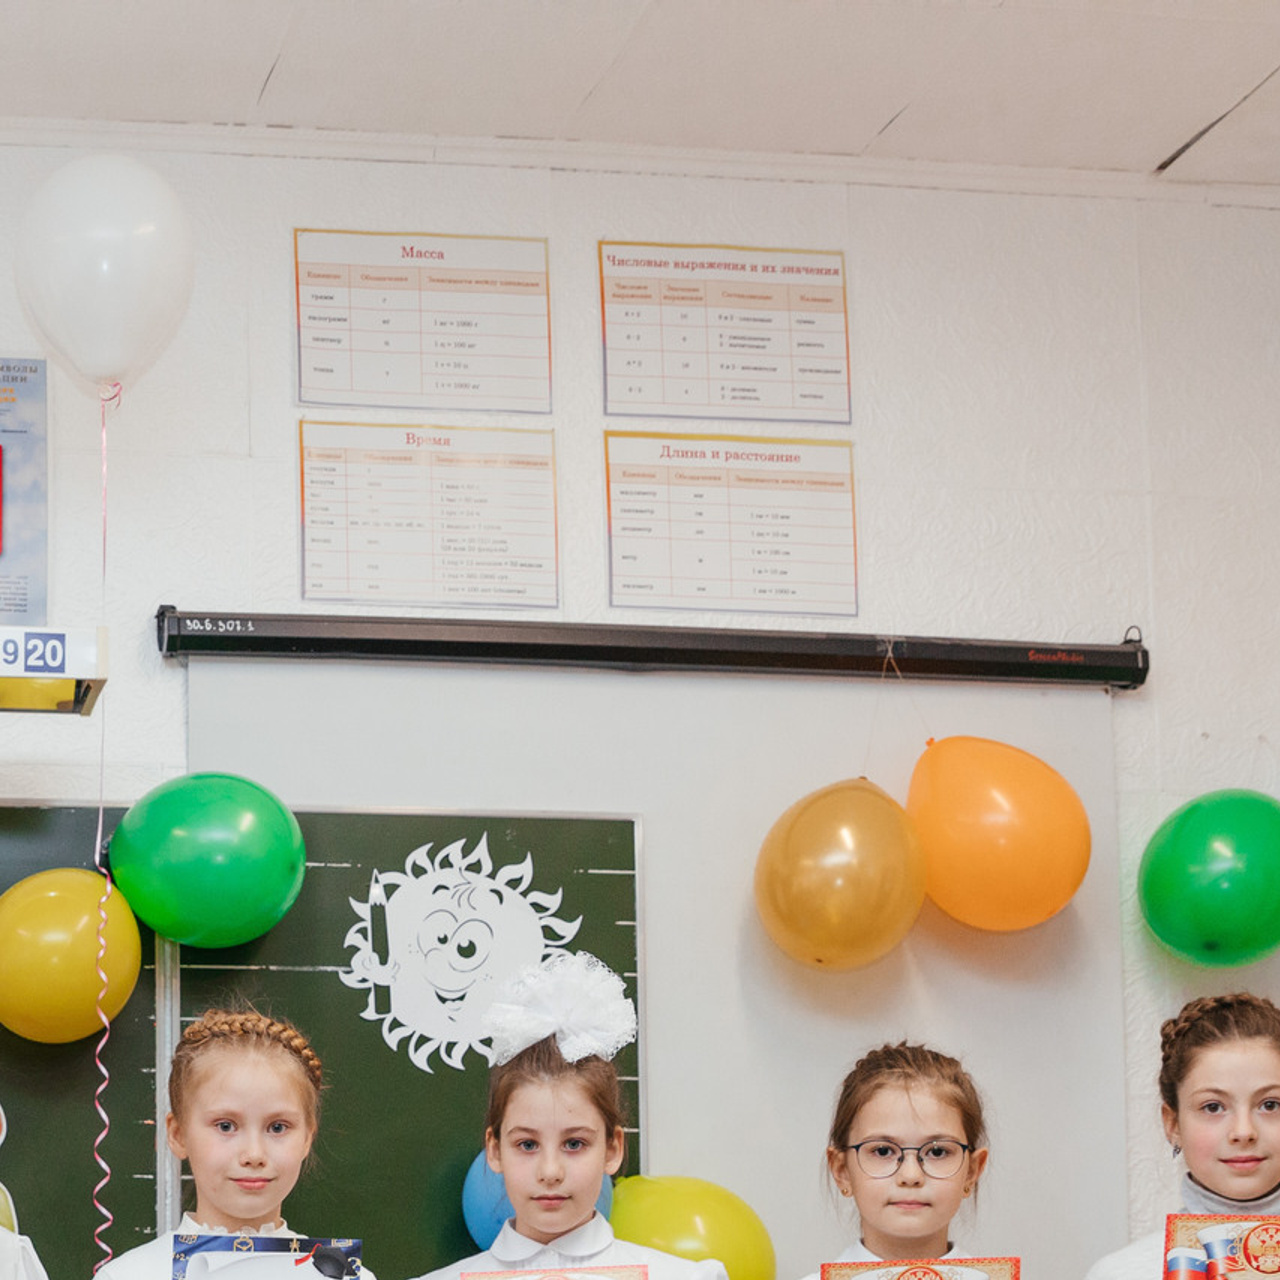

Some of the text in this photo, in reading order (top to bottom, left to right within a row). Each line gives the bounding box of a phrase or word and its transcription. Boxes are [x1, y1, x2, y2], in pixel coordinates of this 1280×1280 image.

[401, 246, 445, 260] Масса
[607, 254, 840, 277] Числовые выражения и их значения
[405, 432, 451, 447] Время
[660, 445, 801, 464] Длина и расстояние
[26, 638, 63, 667] 20
